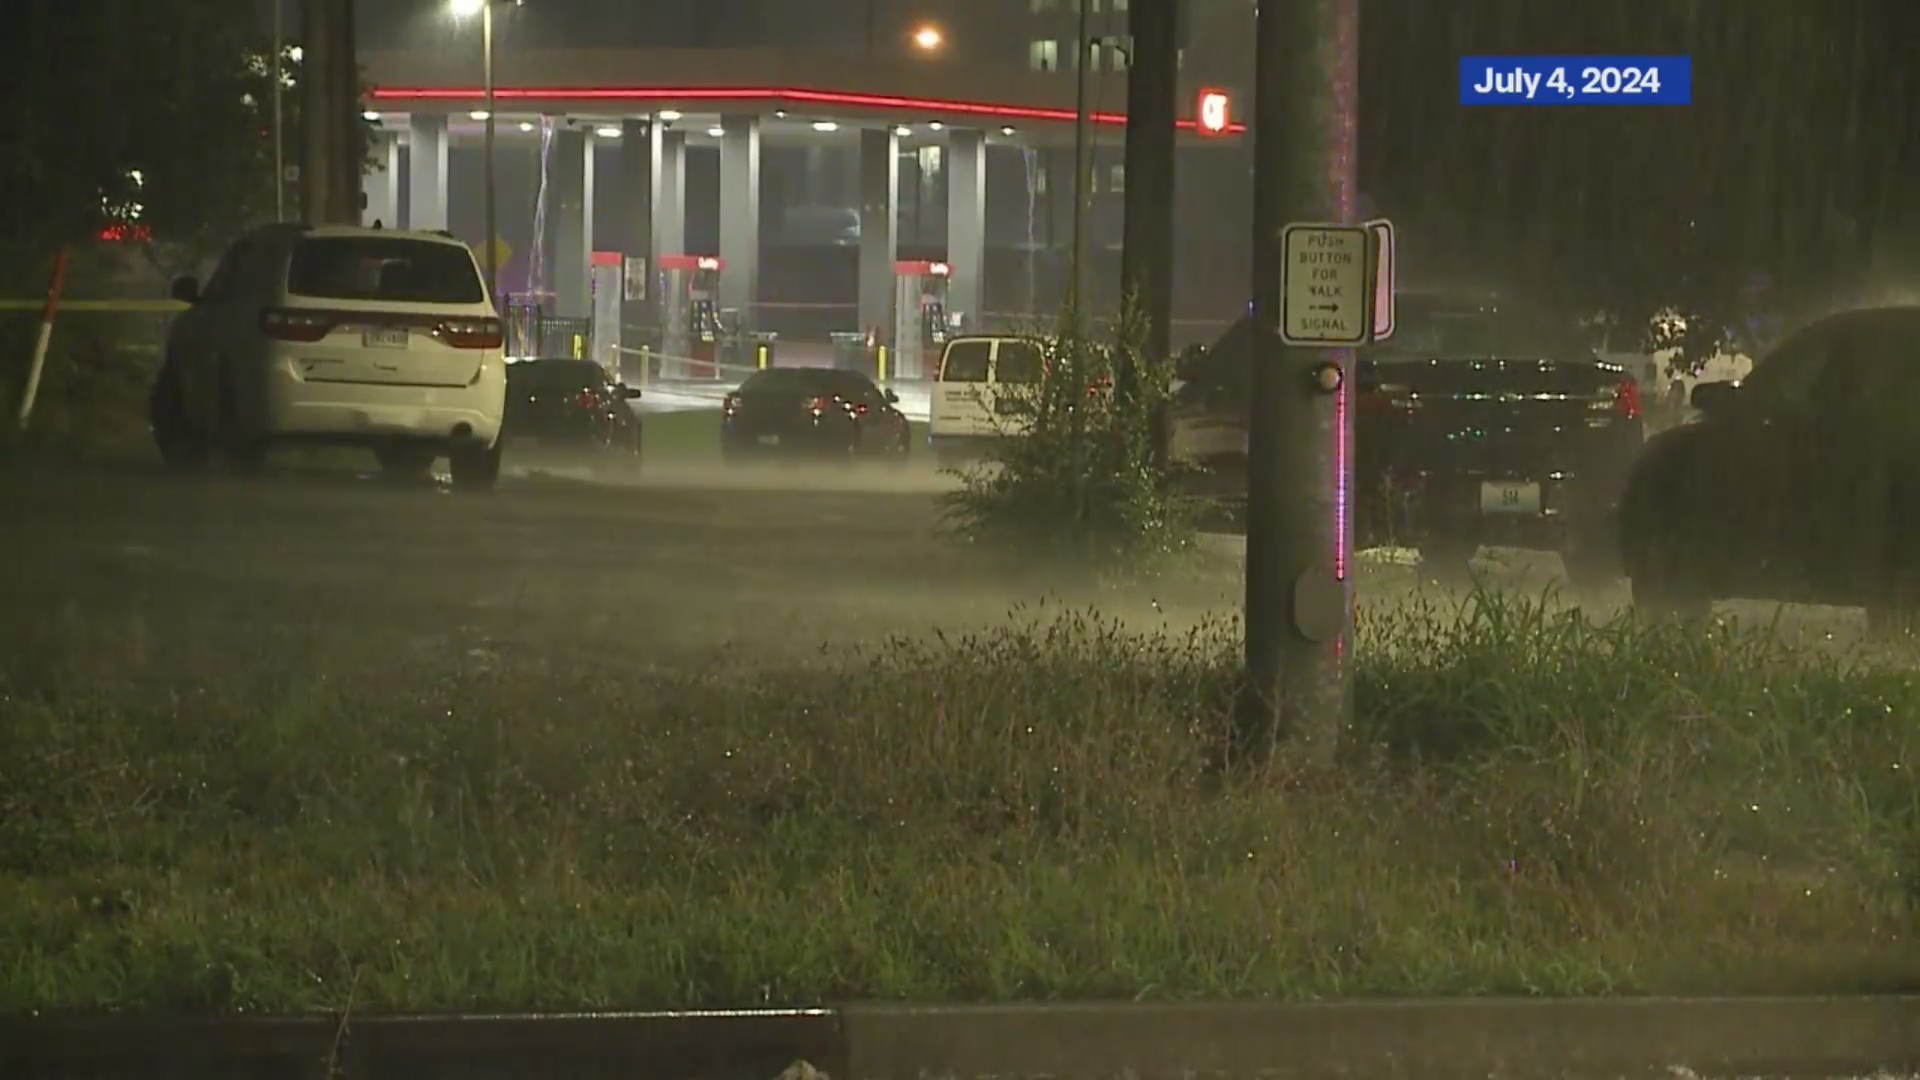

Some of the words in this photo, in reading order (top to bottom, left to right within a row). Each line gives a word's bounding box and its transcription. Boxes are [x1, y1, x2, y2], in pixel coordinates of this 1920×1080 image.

[1308, 235, 1344, 247] PUSH
[1299, 252, 1352, 264] BUTTON
[1312, 268, 1337, 280] FOR
[1301, 318, 1346, 331] SIGNAL
